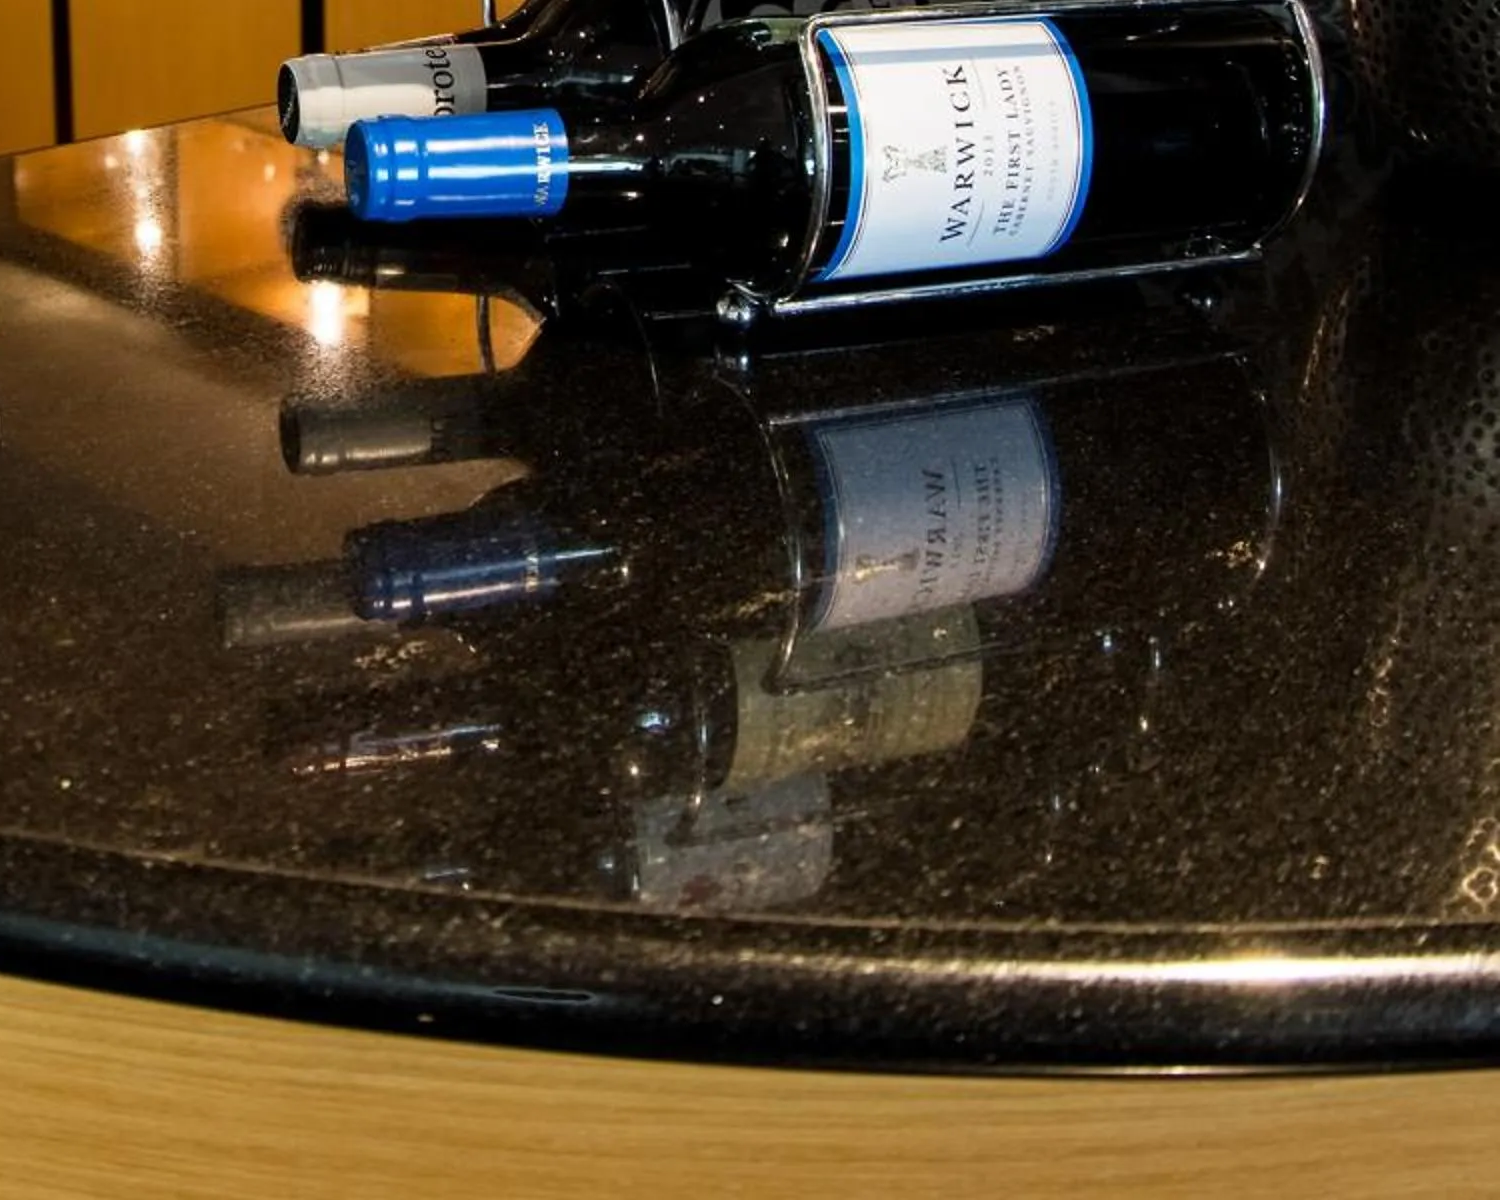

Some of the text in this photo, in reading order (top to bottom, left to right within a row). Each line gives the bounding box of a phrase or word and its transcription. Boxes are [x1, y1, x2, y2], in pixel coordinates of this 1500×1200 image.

[533, 121, 552, 207] WARWICK
[938, 64, 977, 244] WARWICK
[992, 66, 1022, 236] THE FIRST LADY
[1013, 65, 1036, 158] SAUVIGNON
